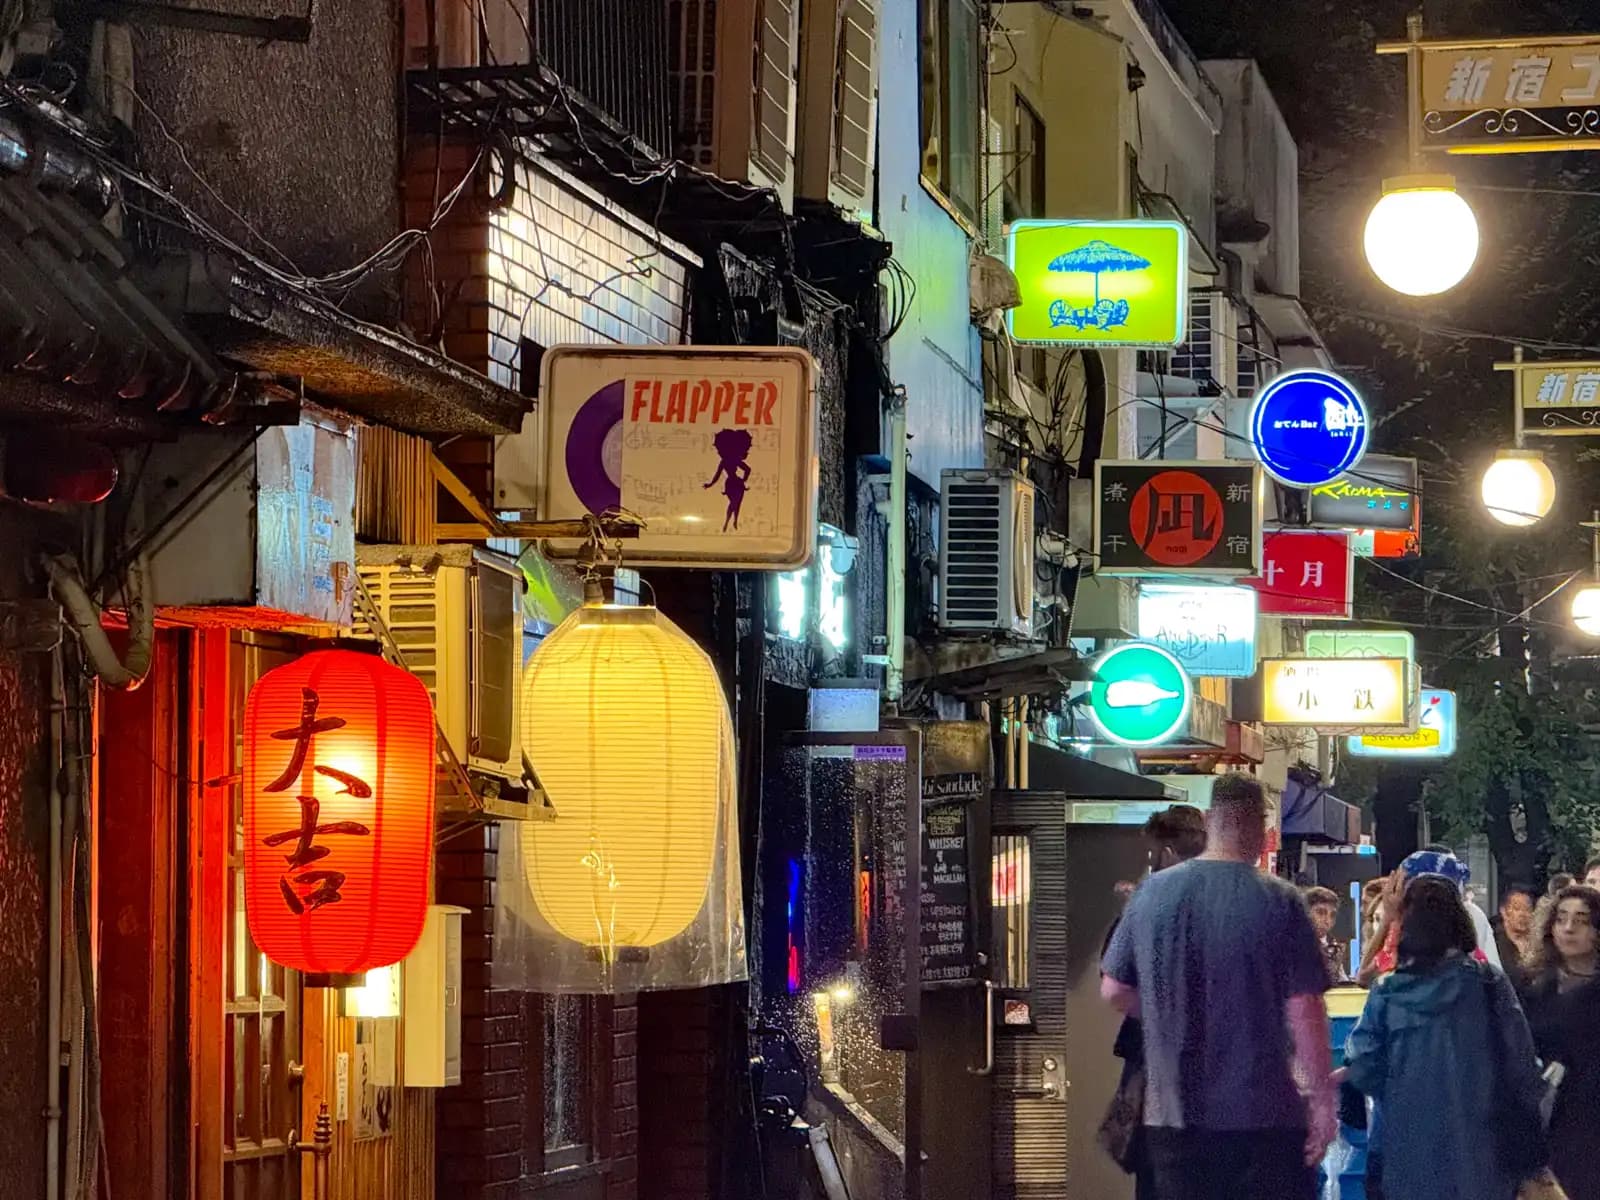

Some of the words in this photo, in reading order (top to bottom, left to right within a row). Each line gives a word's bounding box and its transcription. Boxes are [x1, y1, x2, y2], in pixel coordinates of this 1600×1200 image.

[630, 378, 779, 426] FLAPPER
[1536, 372, 1600, 403] 新宿
[1103, 482, 1128, 553] 煮干
[1142, 482, 1218, 551] 凪
[1226, 483, 1251, 554] 新宿
[1165, 545, 1188, 554] nagi
[1263, 559, 1324, 588] 十月
[262, 687, 371, 915] 大吉
